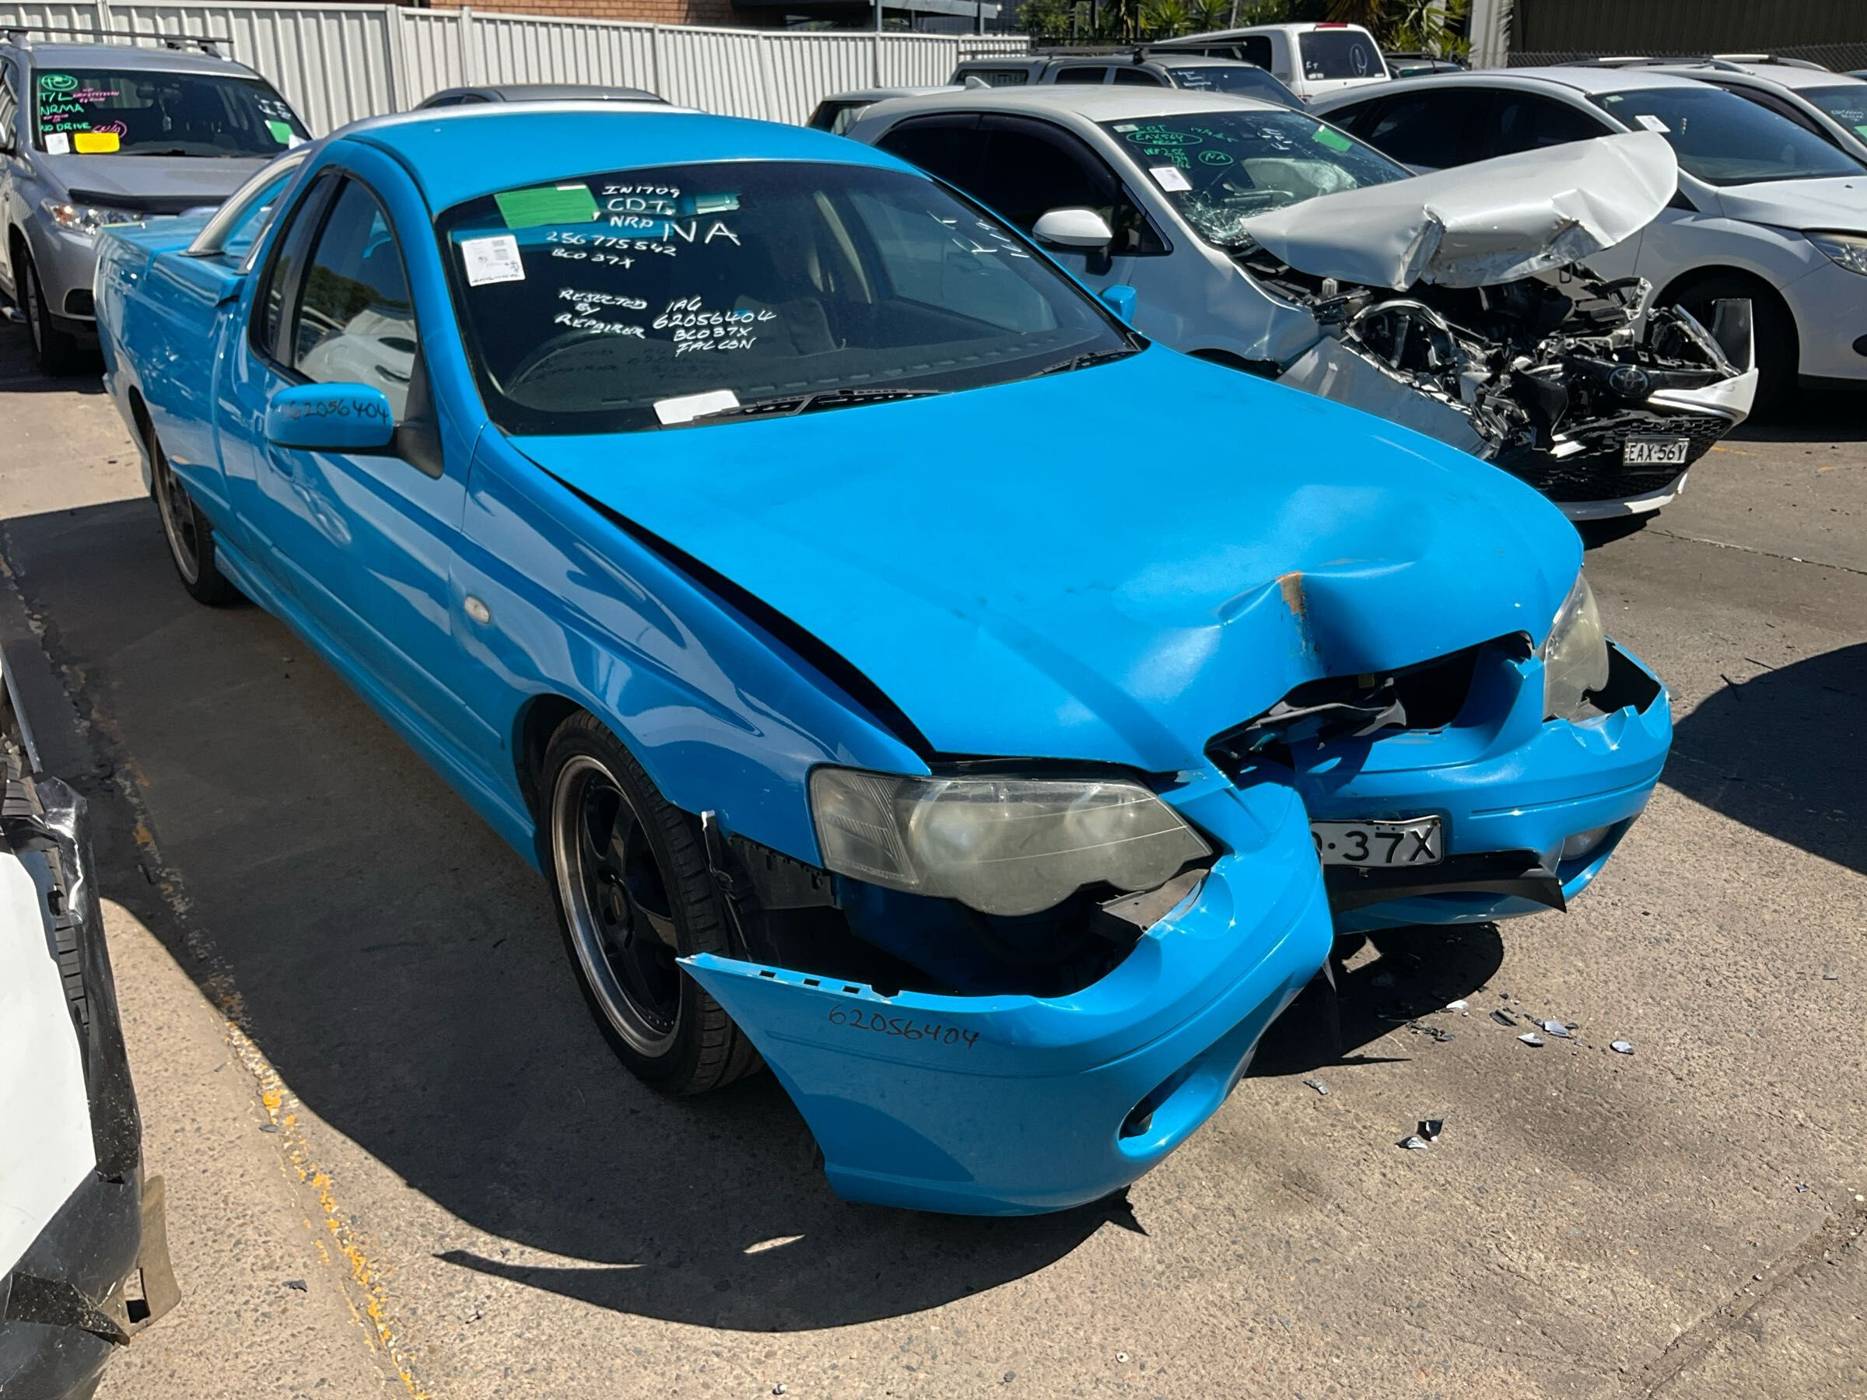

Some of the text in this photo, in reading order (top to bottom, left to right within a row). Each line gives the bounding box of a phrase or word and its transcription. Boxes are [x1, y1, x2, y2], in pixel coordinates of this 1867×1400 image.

[40, 104, 84, 115] NRMA
[56, 122, 91, 131] DRIVE
[828, 1004, 981, 1049] 62056404
